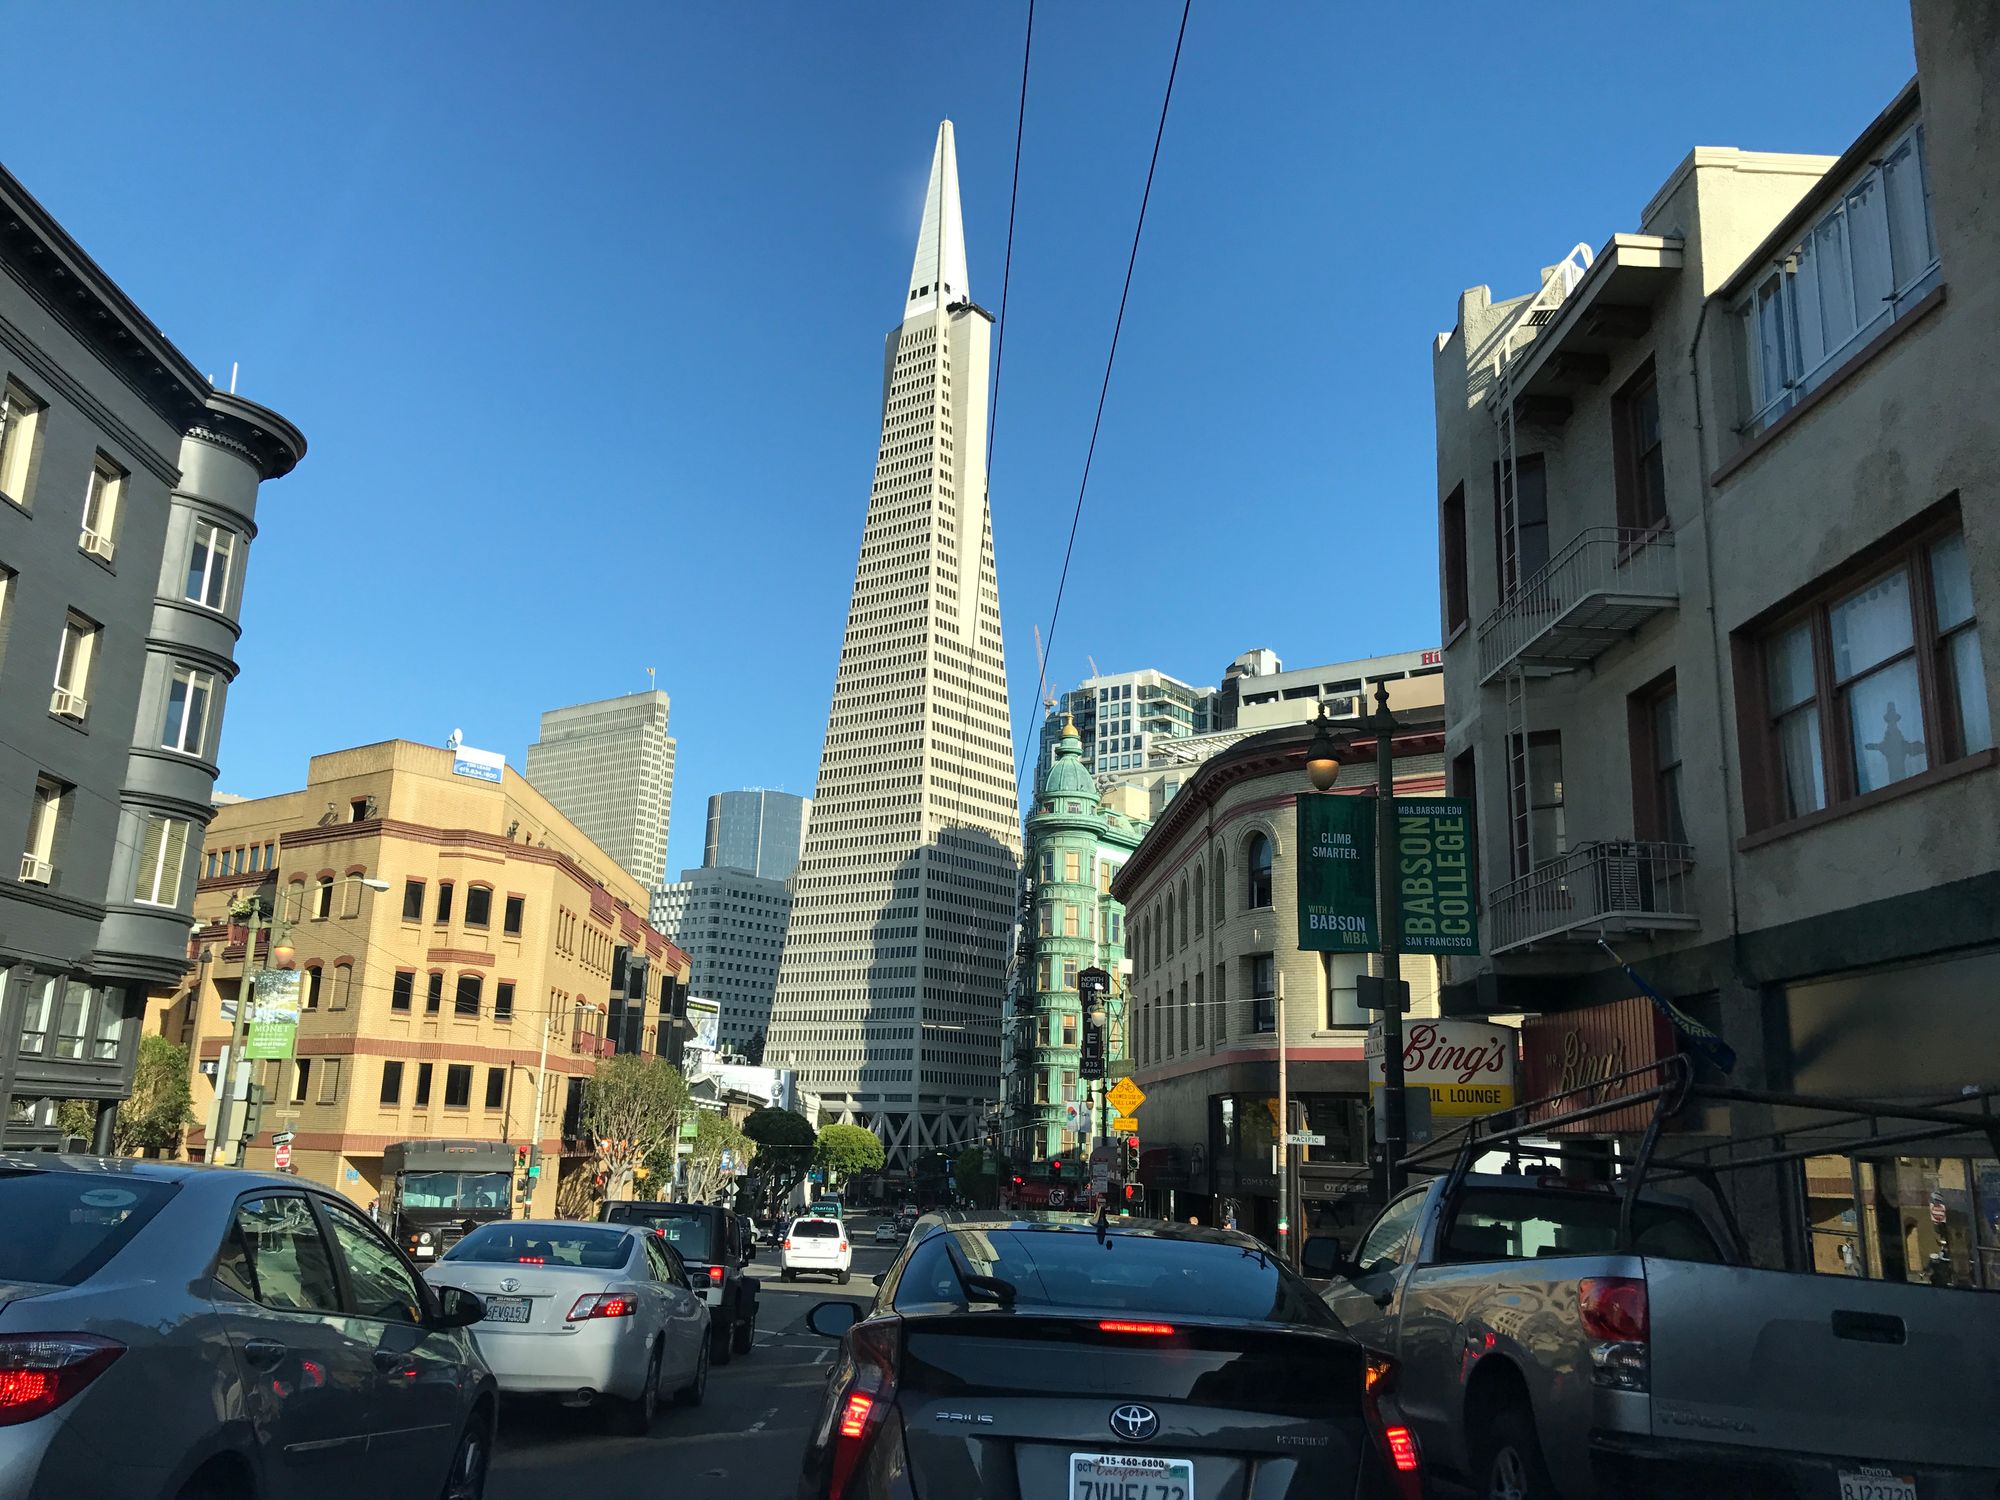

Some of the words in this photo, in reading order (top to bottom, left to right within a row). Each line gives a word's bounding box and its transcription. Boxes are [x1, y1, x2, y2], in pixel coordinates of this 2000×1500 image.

[1398, 806, 1462, 815] MBA.BABSON.EDU
[1321, 832, 1351, 845] CLIMB
[1312, 846, 1360, 860] SMARTER.
[1400, 817, 1436, 934] BABSON
[1435, 817, 1470, 935] COLLEGE
[1308, 904, 1327, 914] WITH
[1328, 905, 1334, 914] A
[1310, 915, 1366, 932] BABSON
[1343, 931, 1369, 945] MBA
[1405, 936, 1422, 947] SAN
[1424, 937, 1472, 947] FRANCISCO
[254, 1025, 289, 1033] MONET
[1381, 1024, 1506, 1084] Bing's
[1450, 1088, 1500, 1104] LOUNGE
[1292, 1136, 1319, 1144] PACIFIC
[936, 1412, 993, 1425] PRIUS
[1077, 1463, 1092, 1472] OCT
[1099, 1456, 1164, 1468] 415-460-6800
[1860, 1466, 1893, 1477] TOYOTA
